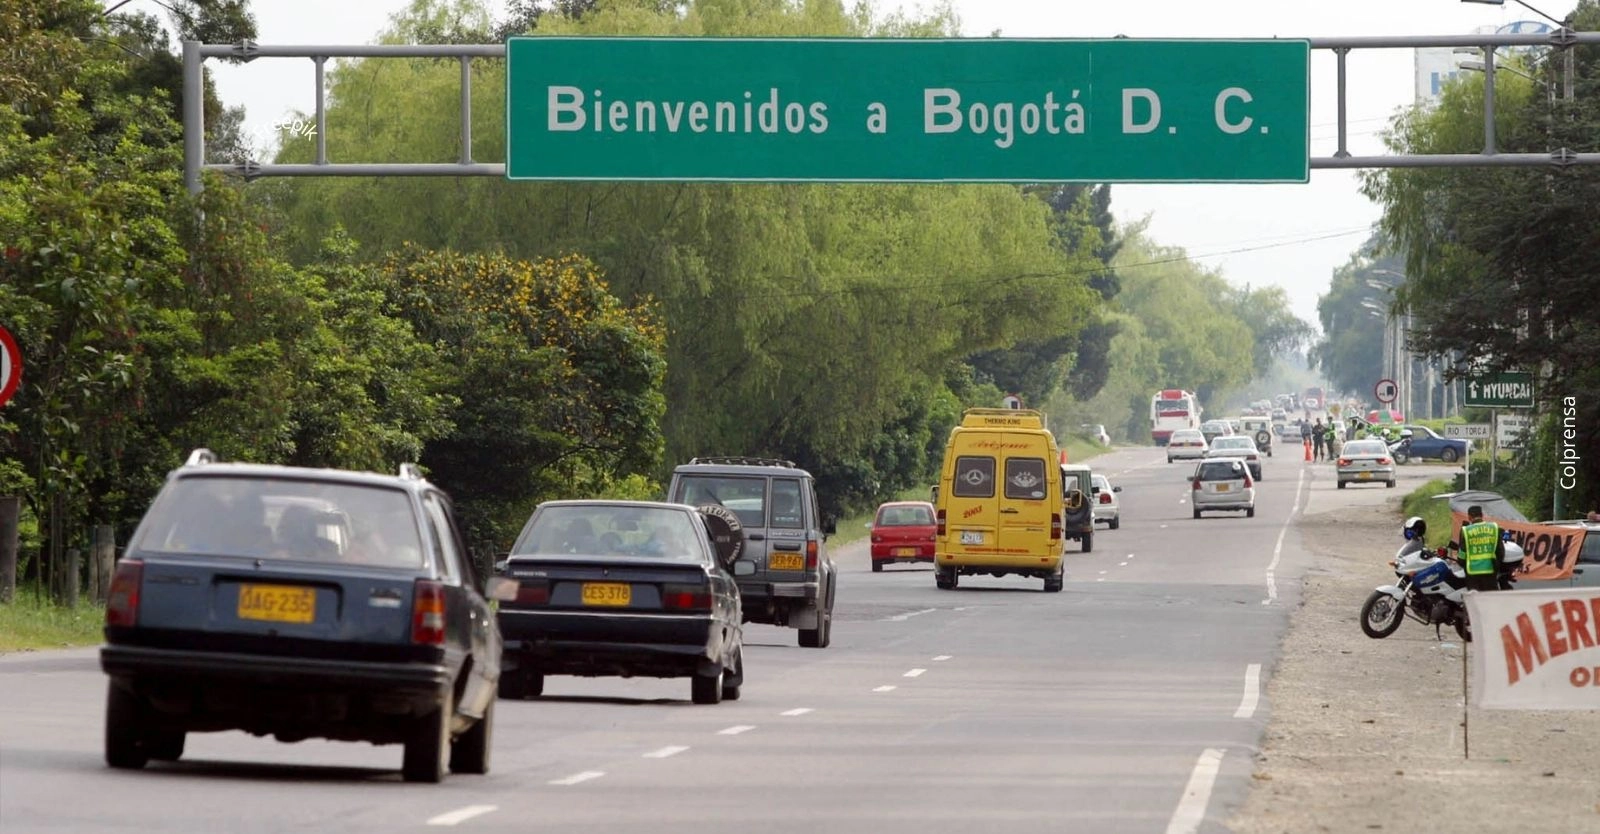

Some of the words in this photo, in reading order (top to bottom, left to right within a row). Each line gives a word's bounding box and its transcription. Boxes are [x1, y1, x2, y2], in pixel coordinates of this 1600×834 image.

[548, 85, 829, 134] Bienvenidos
[865, 102, 887, 134] a
[924, 88, 1085, 148] Bogotá
[1122, 87, 1177, 135] D.
[1214, 87, 1269, 135] C.
